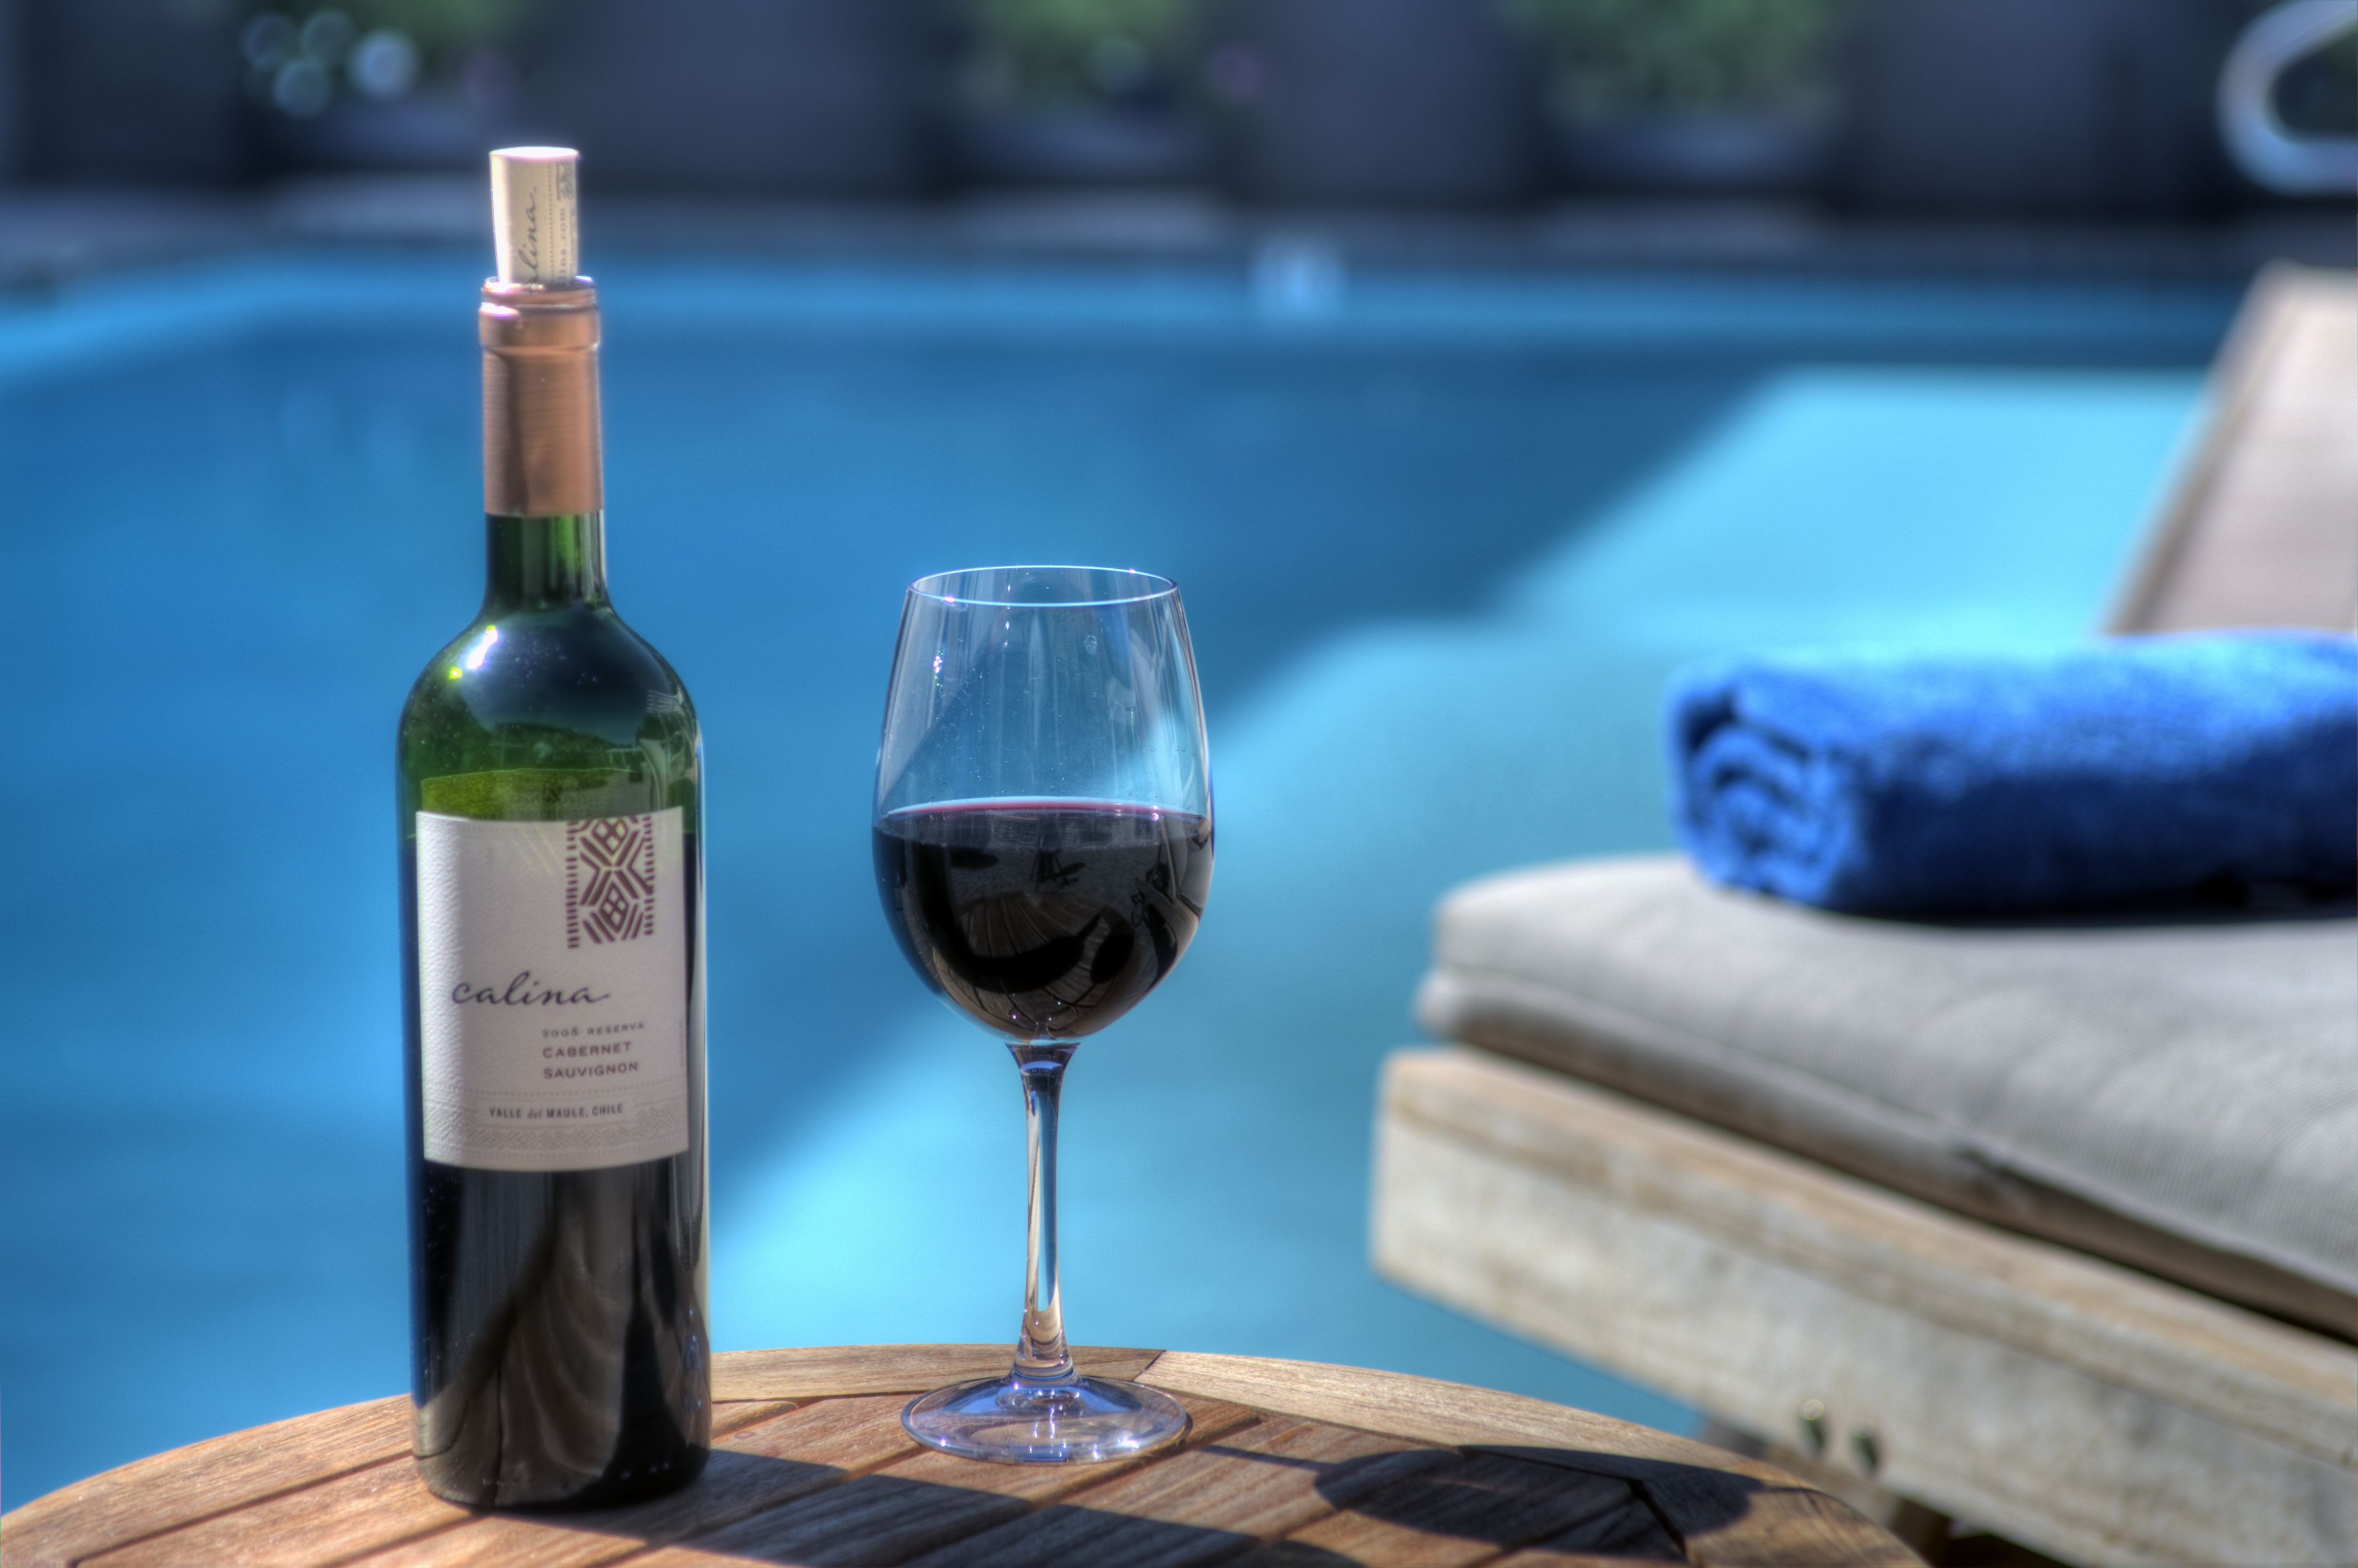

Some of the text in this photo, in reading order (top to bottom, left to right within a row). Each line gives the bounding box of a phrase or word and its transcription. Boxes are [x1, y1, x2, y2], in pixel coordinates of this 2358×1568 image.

[452, 970, 610, 1005] calina
[587, 1022, 644, 1035] RESERVA
[542, 1041, 631, 1058] CABERNET
[543, 1062, 639, 1079] SAUVIGNON
[489, 1108, 521, 1119] VALLE
[527, 1109, 542, 1119] del
[592, 1103, 623, 1116] CHILE
